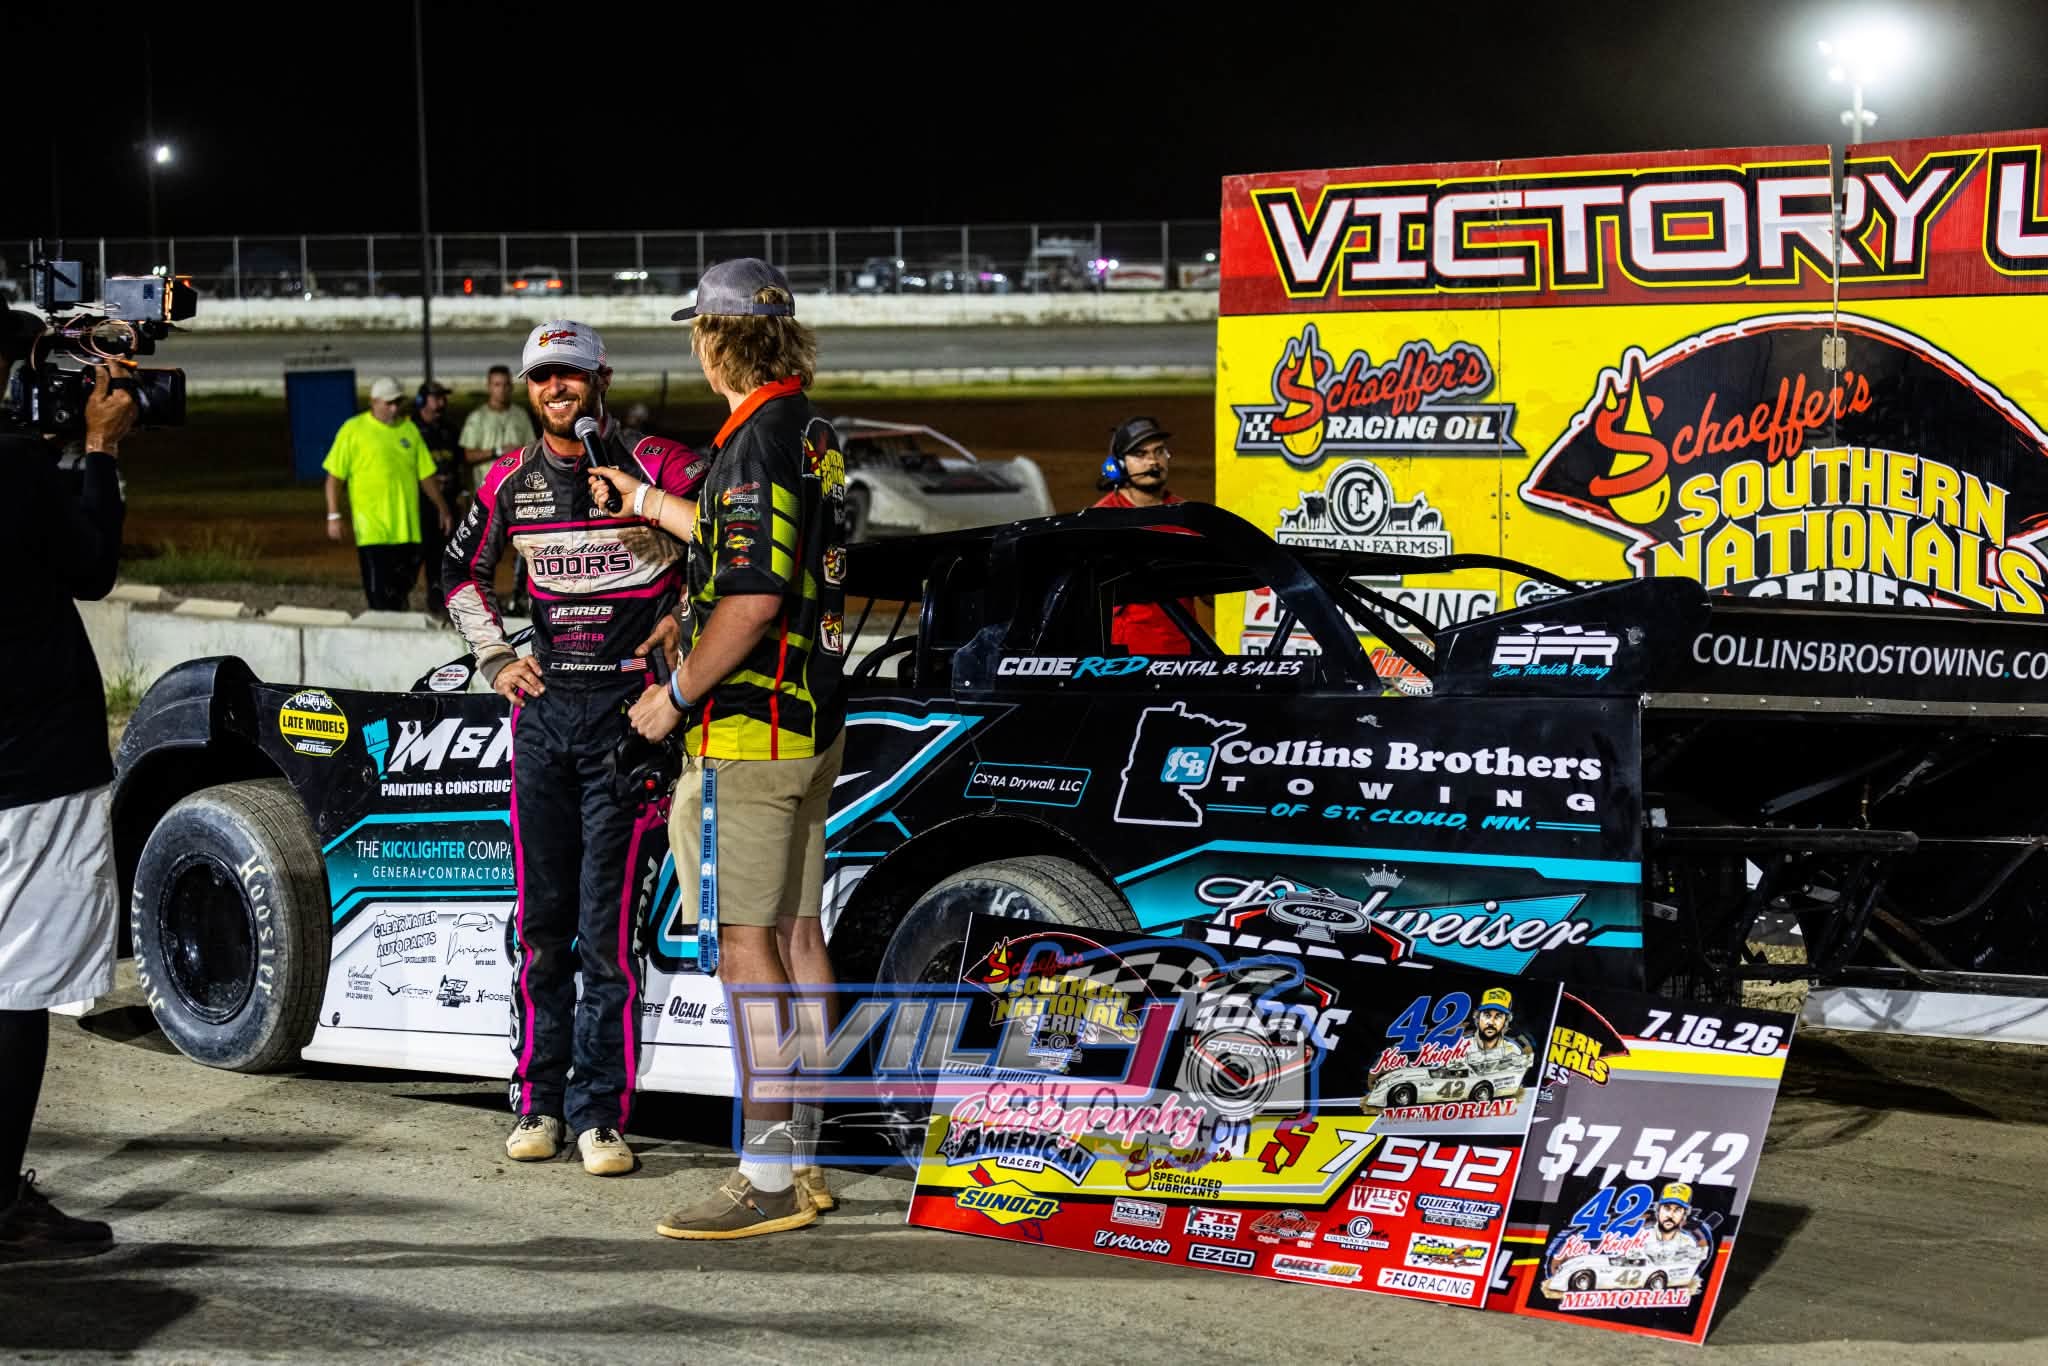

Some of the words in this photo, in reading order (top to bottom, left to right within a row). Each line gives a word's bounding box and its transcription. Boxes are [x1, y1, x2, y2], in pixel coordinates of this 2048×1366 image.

[1267, 165, 1955, 284] VICTORY
[1271, 350, 1484, 434] Schaeffer's
[1326, 415, 1438, 440] RACING
[1443, 415, 1496, 440] OIL
[1588, 371, 1873, 497] Schaeffer's
[1678, 446, 2009, 548] SOUTHERN
[533, 553, 632, 576] DOORS
[1652, 509, 2046, 613] NATIONALS
[1492, 636, 1619, 665] BFR
[997, 657, 1073, 675] CODE
[1073, 656, 1149, 679] RED
[1146, 661, 1217, 676] RENTAL
[1226, 662, 1238, 675] &
[1241, 661, 1303, 676] SALES
[282, 715, 304, 729] LATE
[305, 719, 345, 735] MODELS
[1220, 740, 1372, 769] Collins
[1385, 741, 1602, 781] Brothers
[381, 782, 432, 797] PAINTING
[435, 783, 444, 795] &
[1009, 776, 1056, 791] Drywall,
[1059, 780, 1083, 792] LLC
[1271, 803, 1301, 817] OF
[1322, 805, 1360, 822] ST.
[1369, 808, 1466, 830] CLOUD,
[1481, 815, 1532, 831] MN.
[356, 841, 379, 858] THE
[381, 841, 465, 859] KICKLIGHTER
[704, 836, 712, 859] HEELS
[374, 911, 438, 938] CLEARWATER
[377, 940, 403, 958] AUTO
[404, 932, 437, 952] PARTS
[1024, 1014, 1098, 1043] SERIES
[1386, 991, 1472, 1052] 42
[1639, 1010, 1784, 1056] 7.16.26
[1206, 1039, 1299, 1061] SPEEDWAY
[1371, 1049, 1408, 1075] Ken
[1411, 1040, 1472, 1068] Knight
[1436, 1080, 1466, 1098] 42
[1383, 1099, 1518, 1123] MEMORIAL
[1000, 1156, 1041, 1170] RACER
[1538, 1117, 1750, 1188] $7,542
[1150, 1181, 1220, 1200] LUBRICANTS
[1153, 1171, 1222, 1189] SPECIALIZED
[960, 1189, 1054, 1218] SUNOCO
[1354, 1186, 1408, 1213] WILES
[1420, 1197, 1460, 1210] QUICK
[1464, 1203, 1499, 1215] TIME
[1570, 1184, 1654, 1241] 42
[1185, 1229, 1235, 1241] ENDS
[1199, 1223, 1236, 1233] ROD
[1341, 1243, 1369, 1251] RACING
[1554, 1235, 1591, 1259] Ken
[1593, 1231, 1650, 1256] Knight
[1561, 1287, 1691, 1310] MEMORIAL
